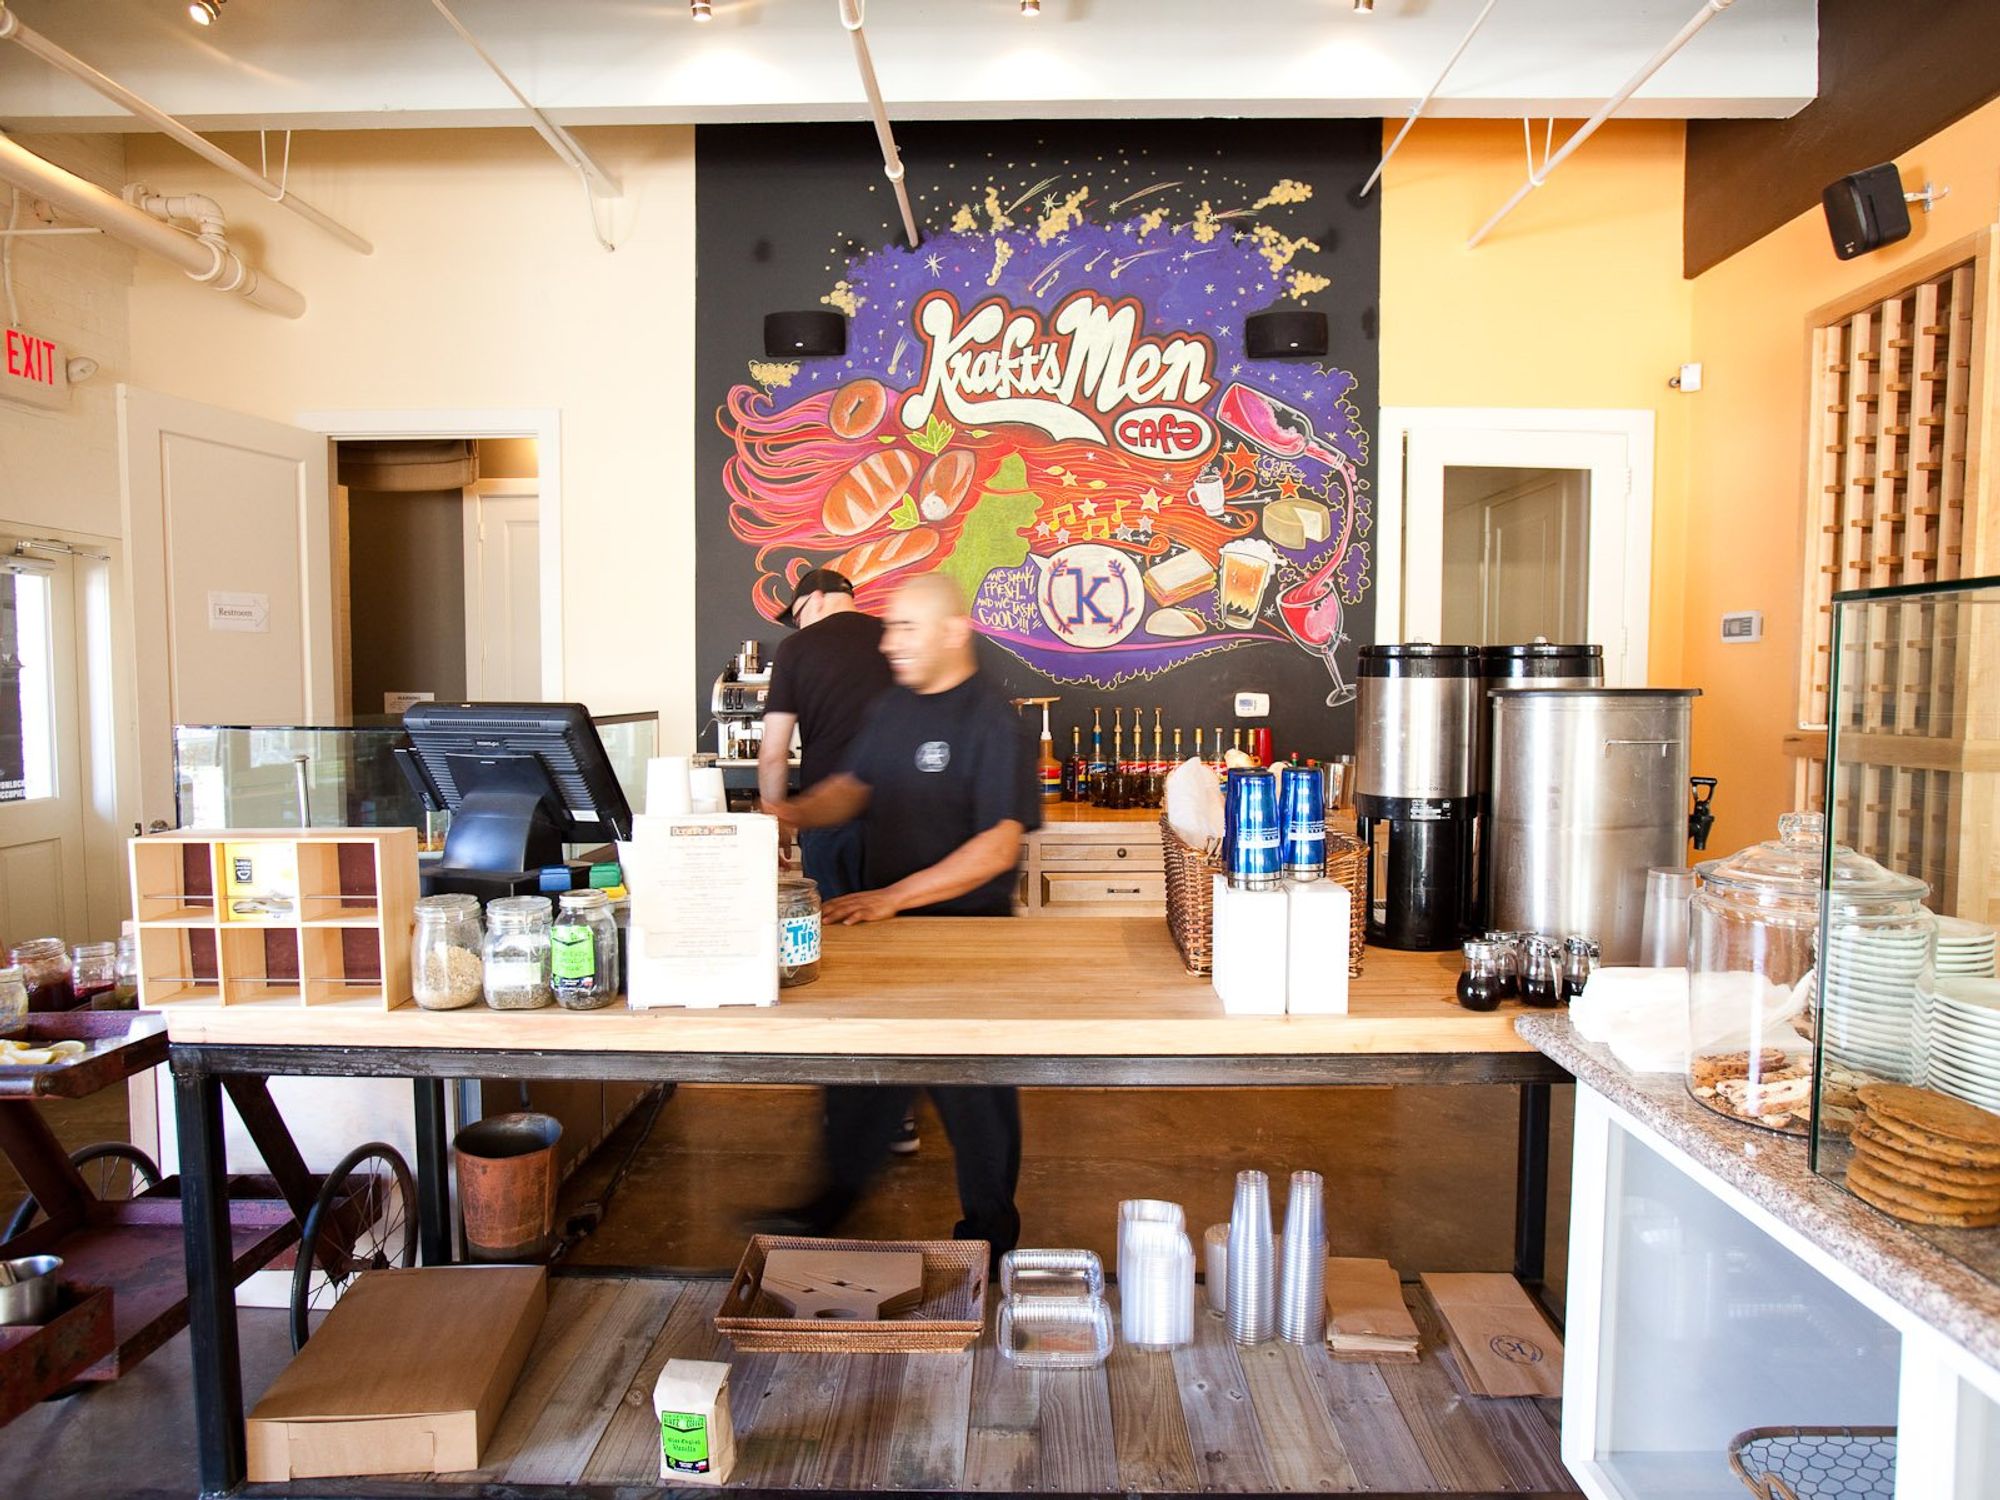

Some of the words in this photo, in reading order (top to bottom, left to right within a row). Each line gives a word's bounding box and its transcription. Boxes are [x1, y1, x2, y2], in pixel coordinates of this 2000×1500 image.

[6, 329, 56, 386] EXIT
[218, 607, 253, 617] Restroom
[786, 923, 818, 952] Tips
